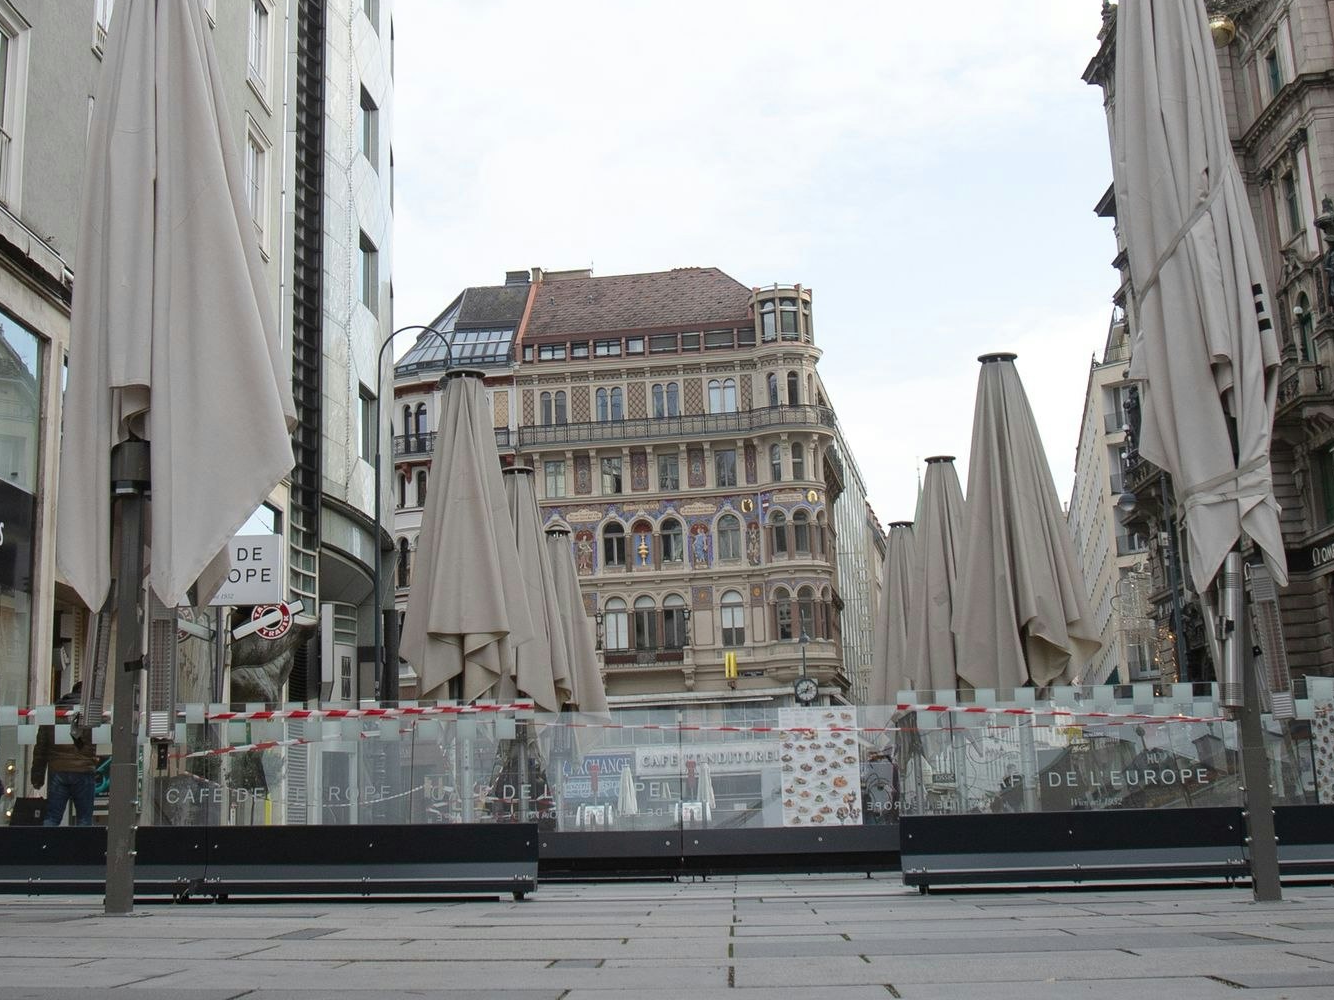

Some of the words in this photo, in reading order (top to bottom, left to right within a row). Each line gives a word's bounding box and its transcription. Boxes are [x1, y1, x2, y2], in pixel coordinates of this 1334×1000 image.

[237, 547, 263, 562] DE
[227, 567, 272, 584] OPE
[261, 615, 290, 638] TRAFIK
[1049, 771, 1078, 788] DE
[1090, 768, 1210, 787] L'EUROPE
[503, 783, 532, 800] DE
